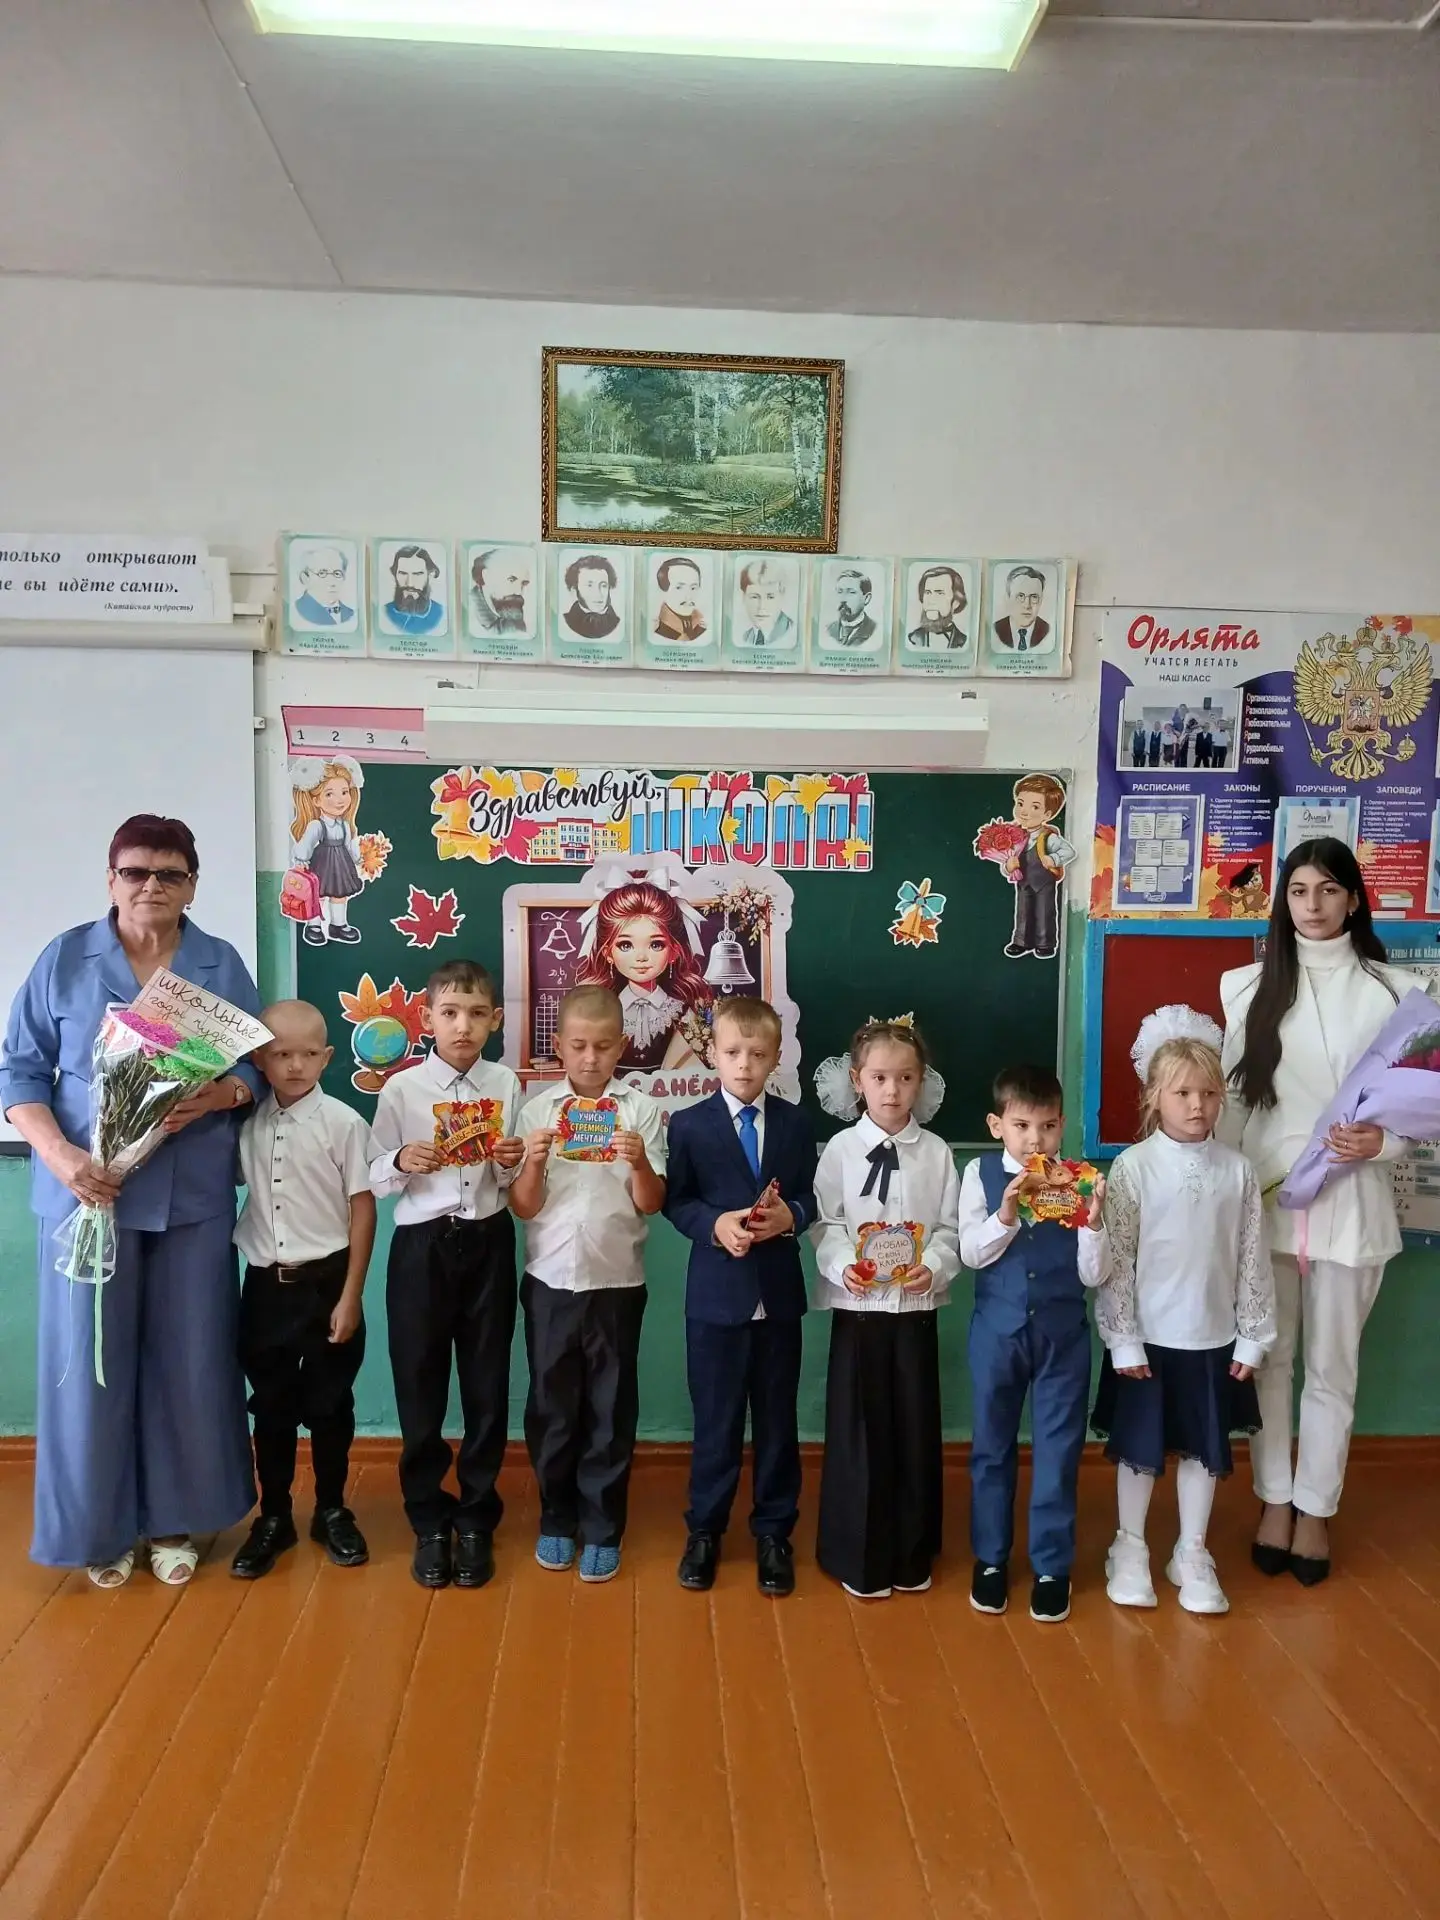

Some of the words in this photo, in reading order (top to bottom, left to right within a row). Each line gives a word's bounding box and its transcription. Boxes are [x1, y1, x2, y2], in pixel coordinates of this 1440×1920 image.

[86, 551, 197, 567] открывают
[24, 581, 47, 592] вы
[58, 578, 115, 593] идёте
[120, 580, 179, 593] сами».
[1127, 614, 1261, 655] Орлята
[1144, 656, 1189, 667] УЧАТСЯ
[1195, 658, 1239, 668] ЛЕТАТЬ
[1159, 674, 1180, 683] НАШ
[1182, 674, 1211, 683] КЛАСС
[298, 730, 305, 740] 1
[332, 731, 340, 742] 2
[366, 733, 375, 744] 3
[400, 735, 409, 746] 4
[1132, 783, 1191, 792] РАСПИСАНИЕ
[1224, 784, 1261, 793] ЗАКОНЫ
[1295, 785, 1347, 794] ПОРУЧЕНИЯ
[1376, 786, 1422, 795] ЗАПОВЕДИ
[468, 770, 663, 839] Здравствуй,
[630, 786, 874, 870] ШКОЛА!
[648, 1073, 722, 1097] ДНЁМ
[577, 1111, 606, 1122] УЧИСЬ!
[570, 1122, 611, 1133] СТРЕМИСЬ!
[573, 1132, 606, 1144] МЕЧТАЙ!
[873, 1239, 909, 1250] ЛЮБЛЮ
